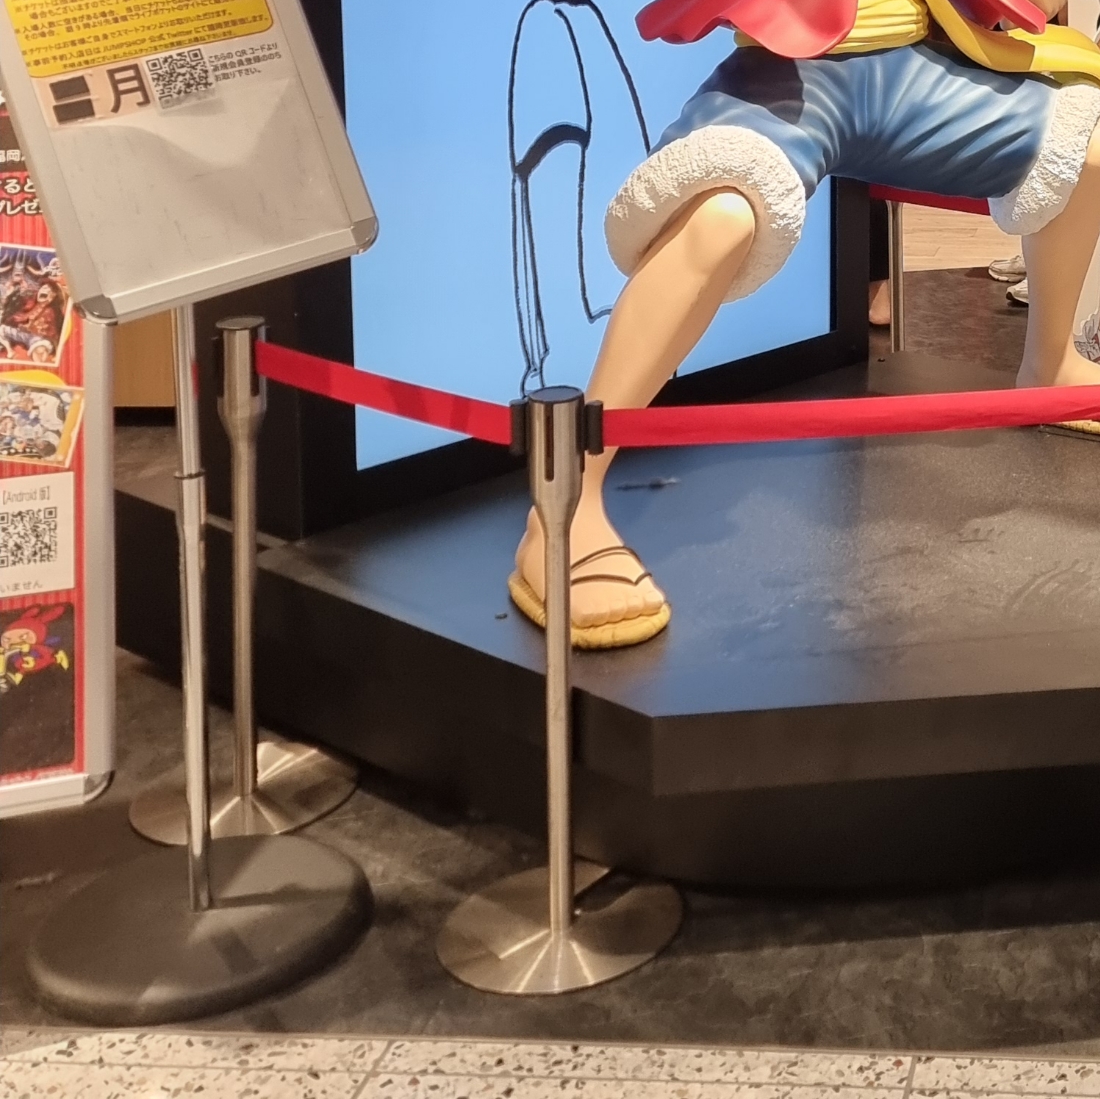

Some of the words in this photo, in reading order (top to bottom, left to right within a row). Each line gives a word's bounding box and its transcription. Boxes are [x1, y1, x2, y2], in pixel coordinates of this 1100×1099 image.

[208, 51, 233, 64] こちらの
[235, 49, 247, 58] QR
[249, 43, 278, 56] コードより
[214, 68, 261, 82] お取り下さい。
